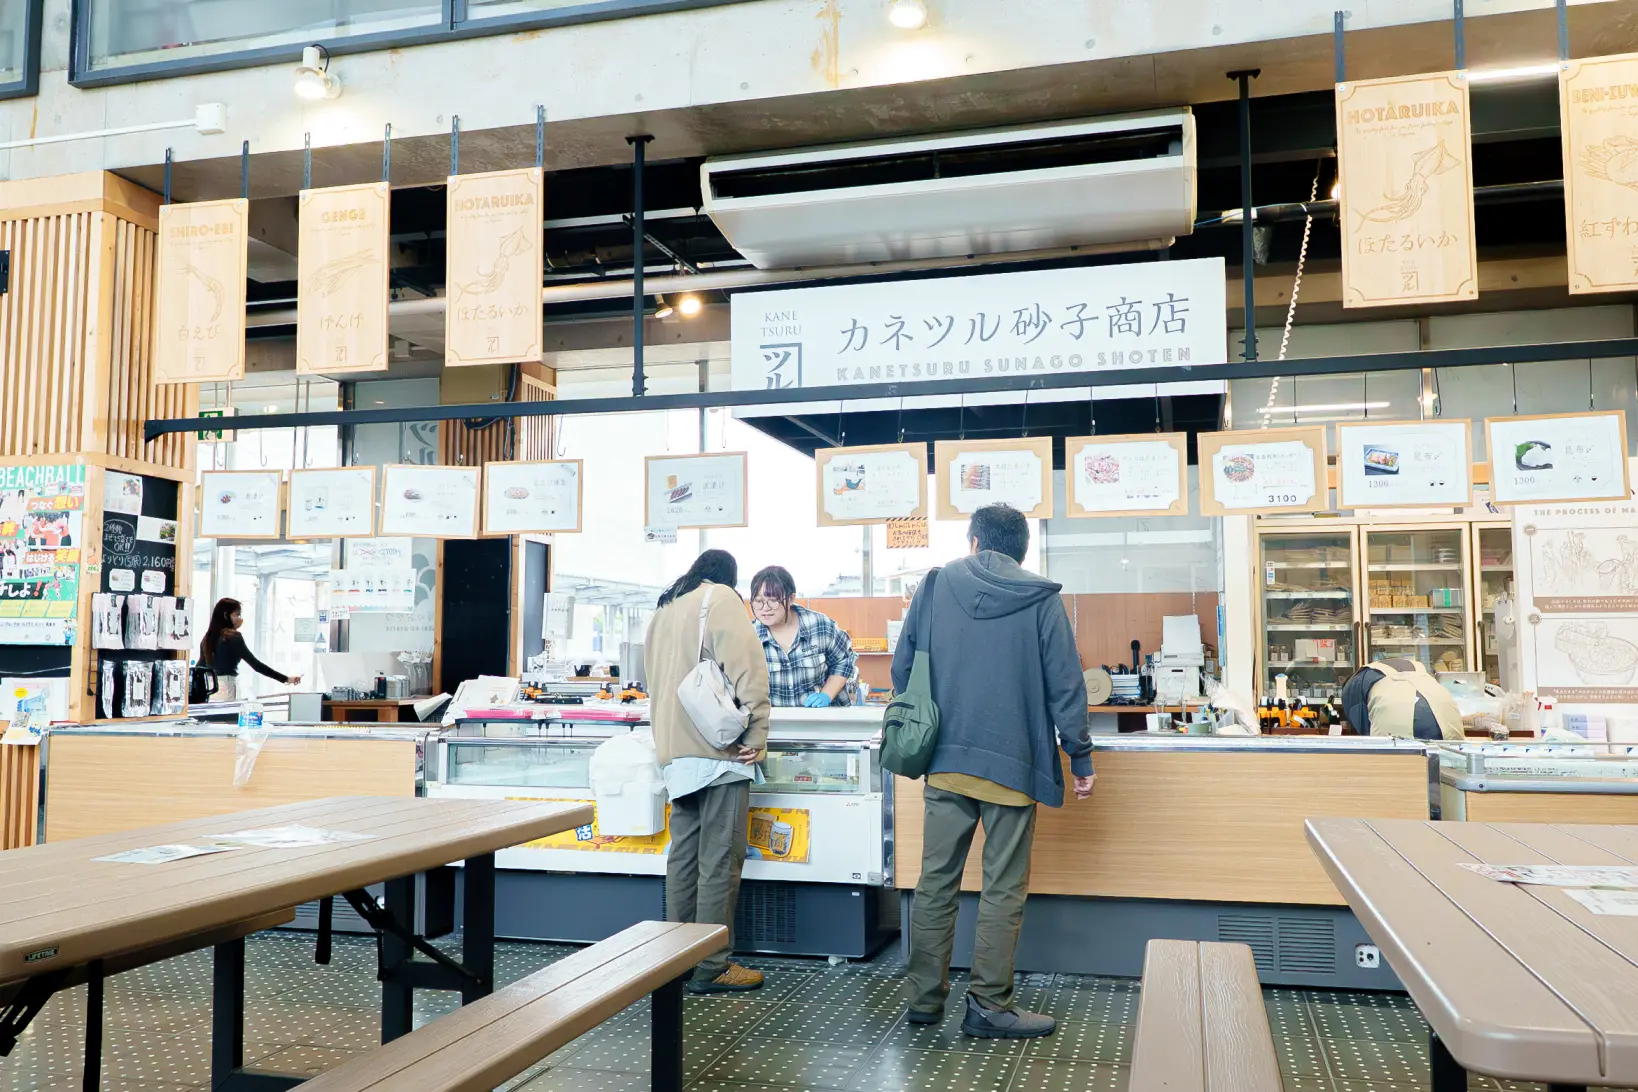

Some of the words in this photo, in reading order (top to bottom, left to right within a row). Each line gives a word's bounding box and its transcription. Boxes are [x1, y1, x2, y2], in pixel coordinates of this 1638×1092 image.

[1347, 100, 1459, 125] HOTARUIKA
[454, 192, 534, 212] HOTARUIKA
[322, 209, 366, 223] GENGE
[169, 222, 234, 238] SHIRO-EBI
[1358, 230, 1457, 254] ほたるいか
[457, 301, 529, 321] ほたるいか
[764, 310, 798, 323] KANE
[320, 314, 364, 331] げんげ
[836, 293, 1190, 355] カネツル砂子商店
[178, 324, 221, 341] 白えび
[760, 325, 802, 338] TSURU
[836, 359, 971, 382] KANETSURU
[984, 354, 1084, 374] SUNAGO
[1097, 347, 1191, 367] SHOTEN
[1368, 480, 1389, 488] 1300
[1514, 476, 1535, 485] 1300
[1268, 495, 1297, 503] 3100
[28, 948, 56, 961] LIFETIME
